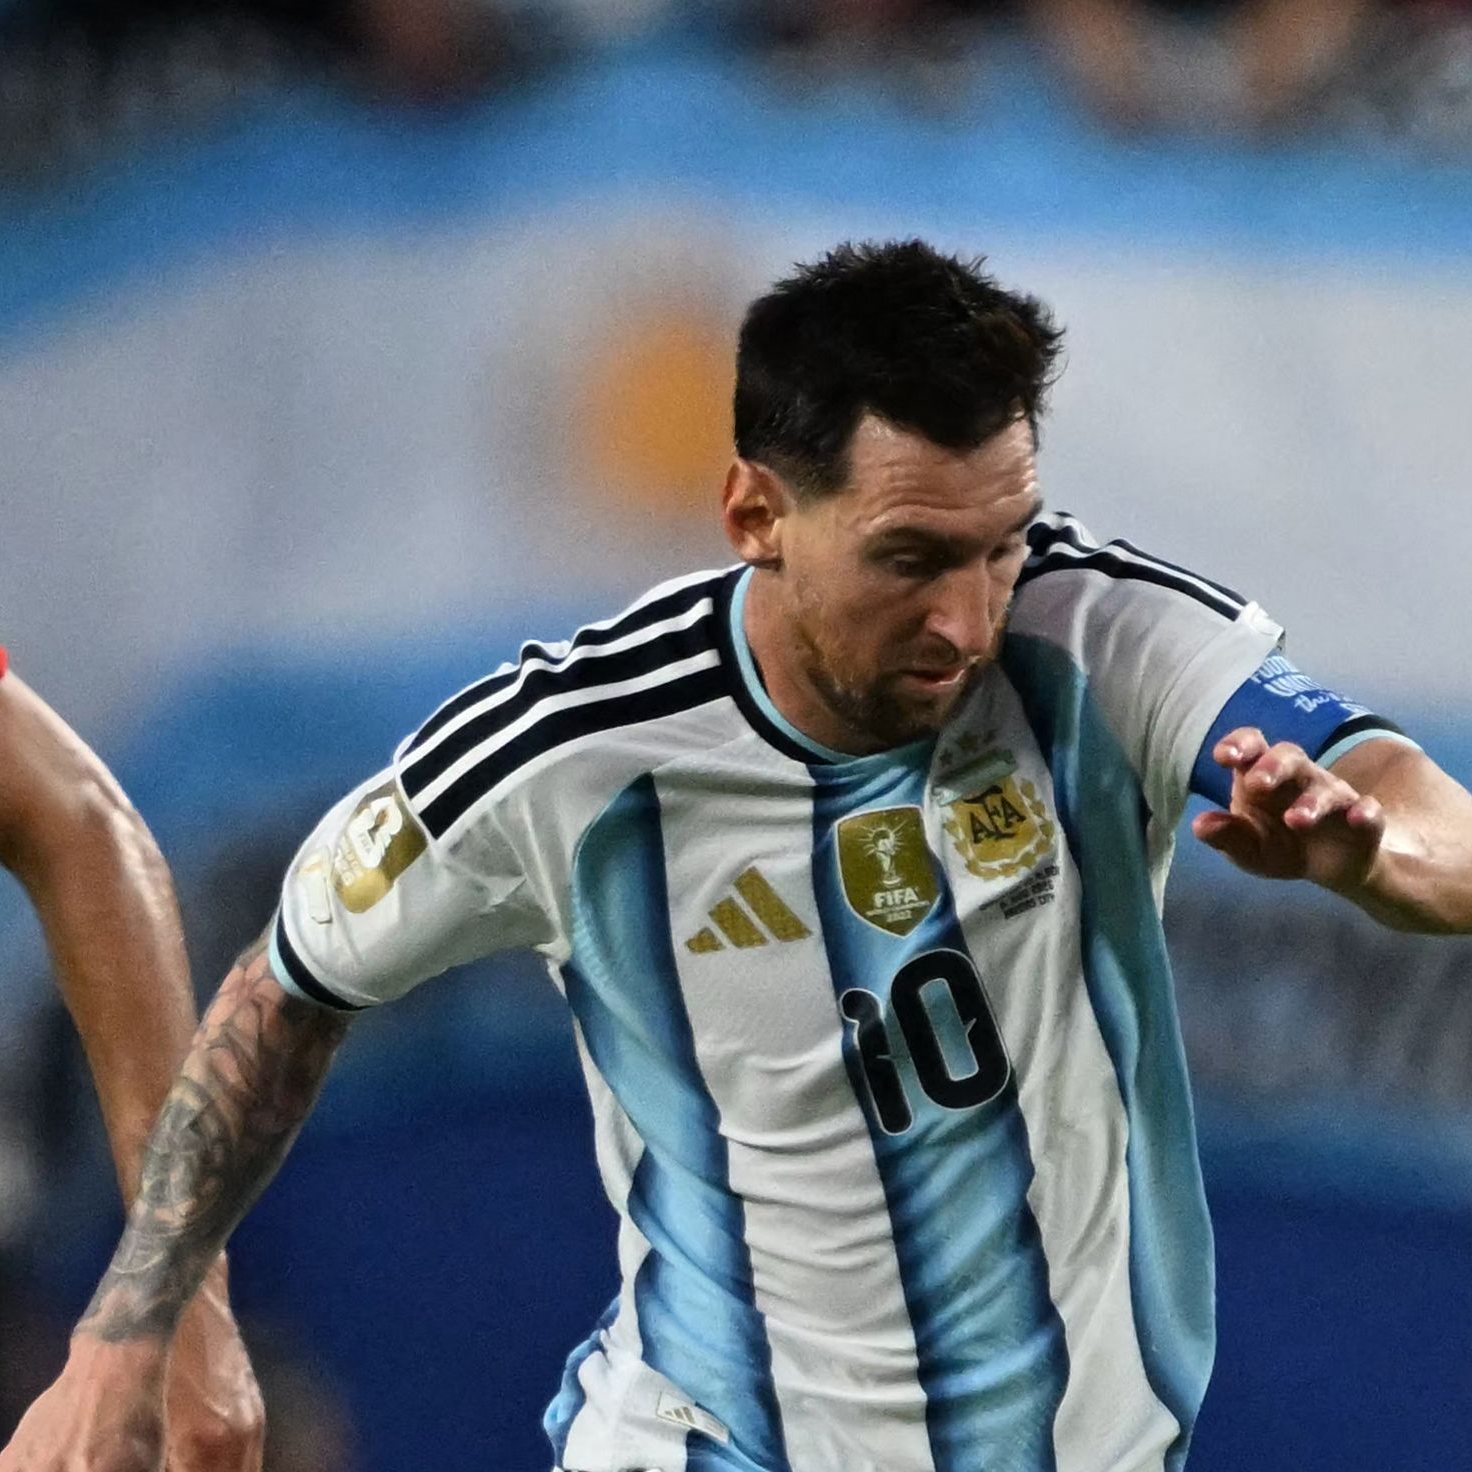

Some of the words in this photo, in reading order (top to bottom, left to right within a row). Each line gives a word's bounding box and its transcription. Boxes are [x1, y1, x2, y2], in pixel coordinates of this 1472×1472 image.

[962, 784, 1027, 844] AFA
[874, 887, 919, 908] FIFA
[840, 948, 1011, 1136] 10
